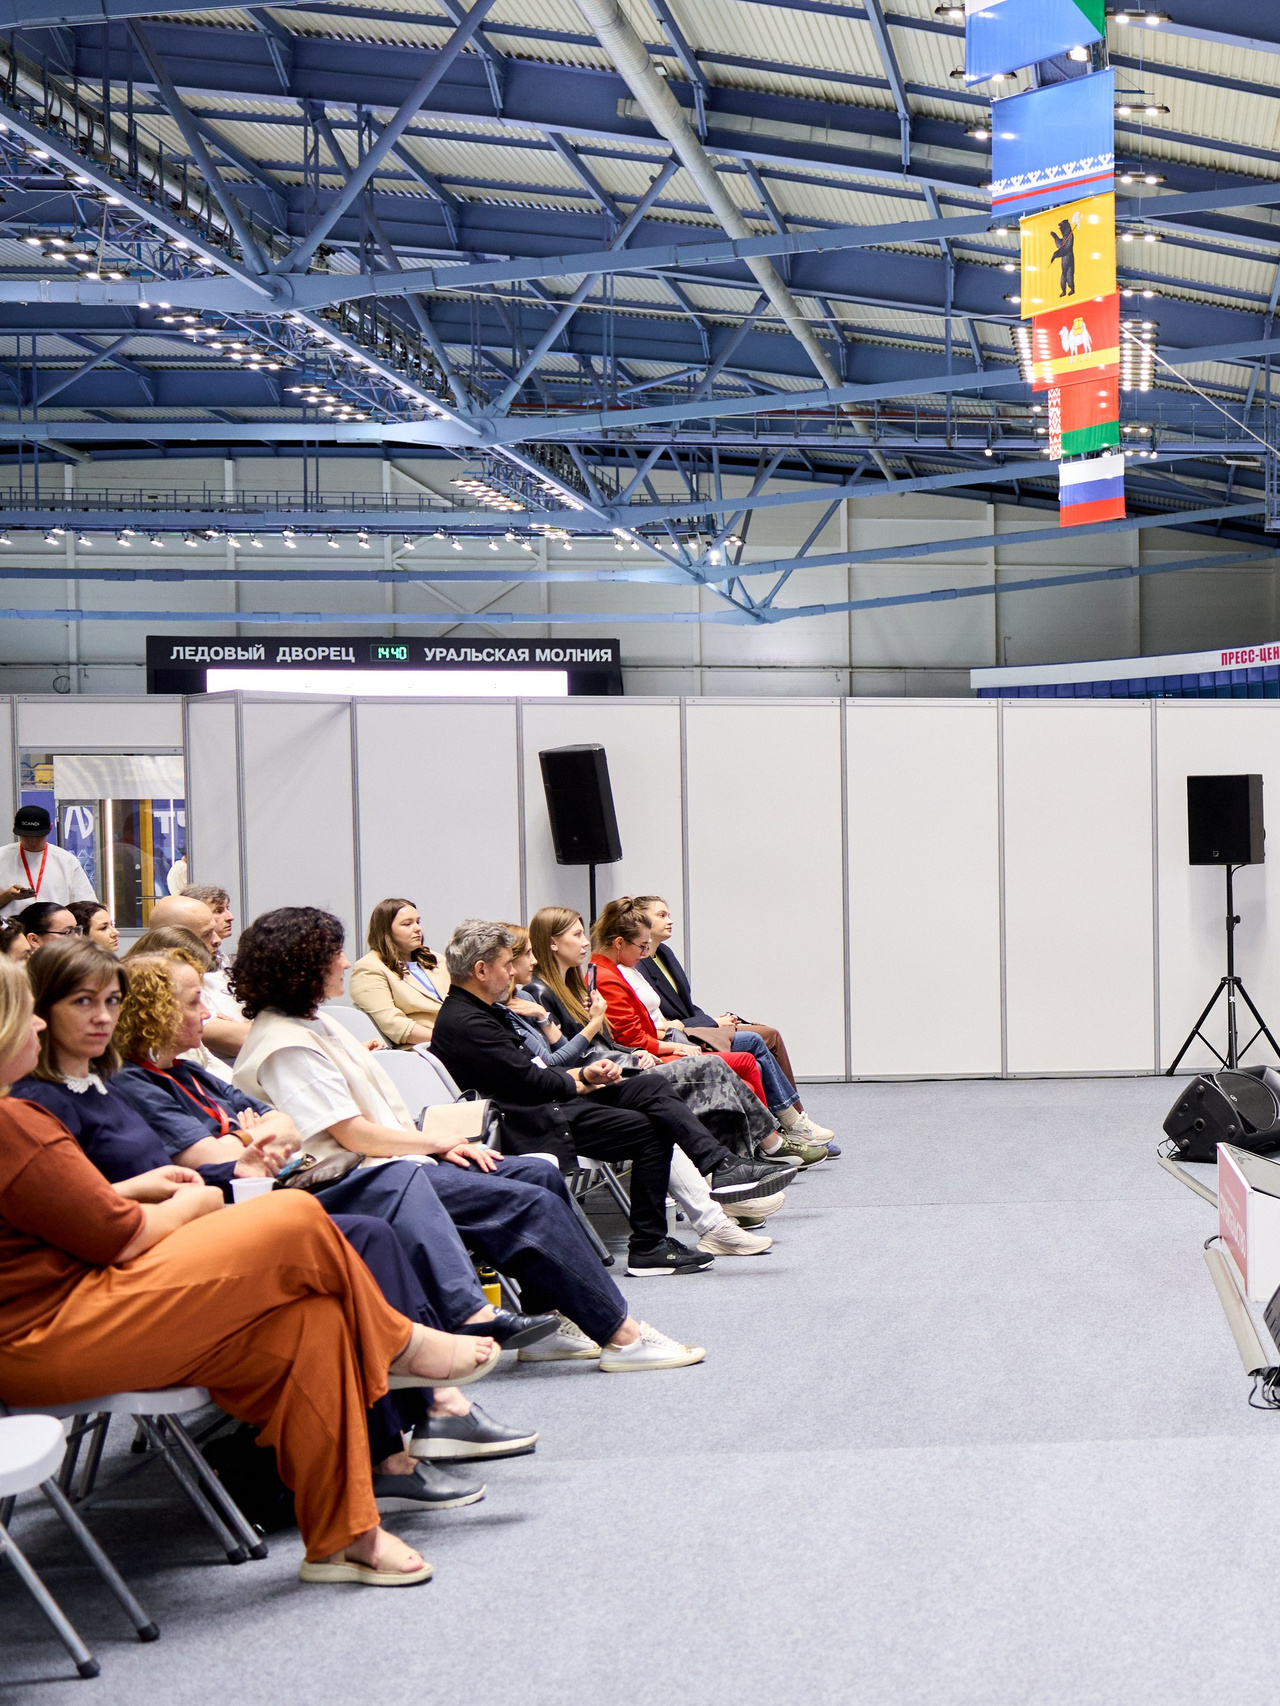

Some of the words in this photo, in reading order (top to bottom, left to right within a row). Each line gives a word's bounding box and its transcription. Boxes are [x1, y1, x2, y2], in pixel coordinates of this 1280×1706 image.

[170, 644, 265, 662] ЛЕДОВЫЙ
[276, 647, 355, 663] ДВОРЕЦ
[424, 647, 530, 662] УРАЛЬСКАЯ
[535, 648, 612, 662] МОЛНИЯ
